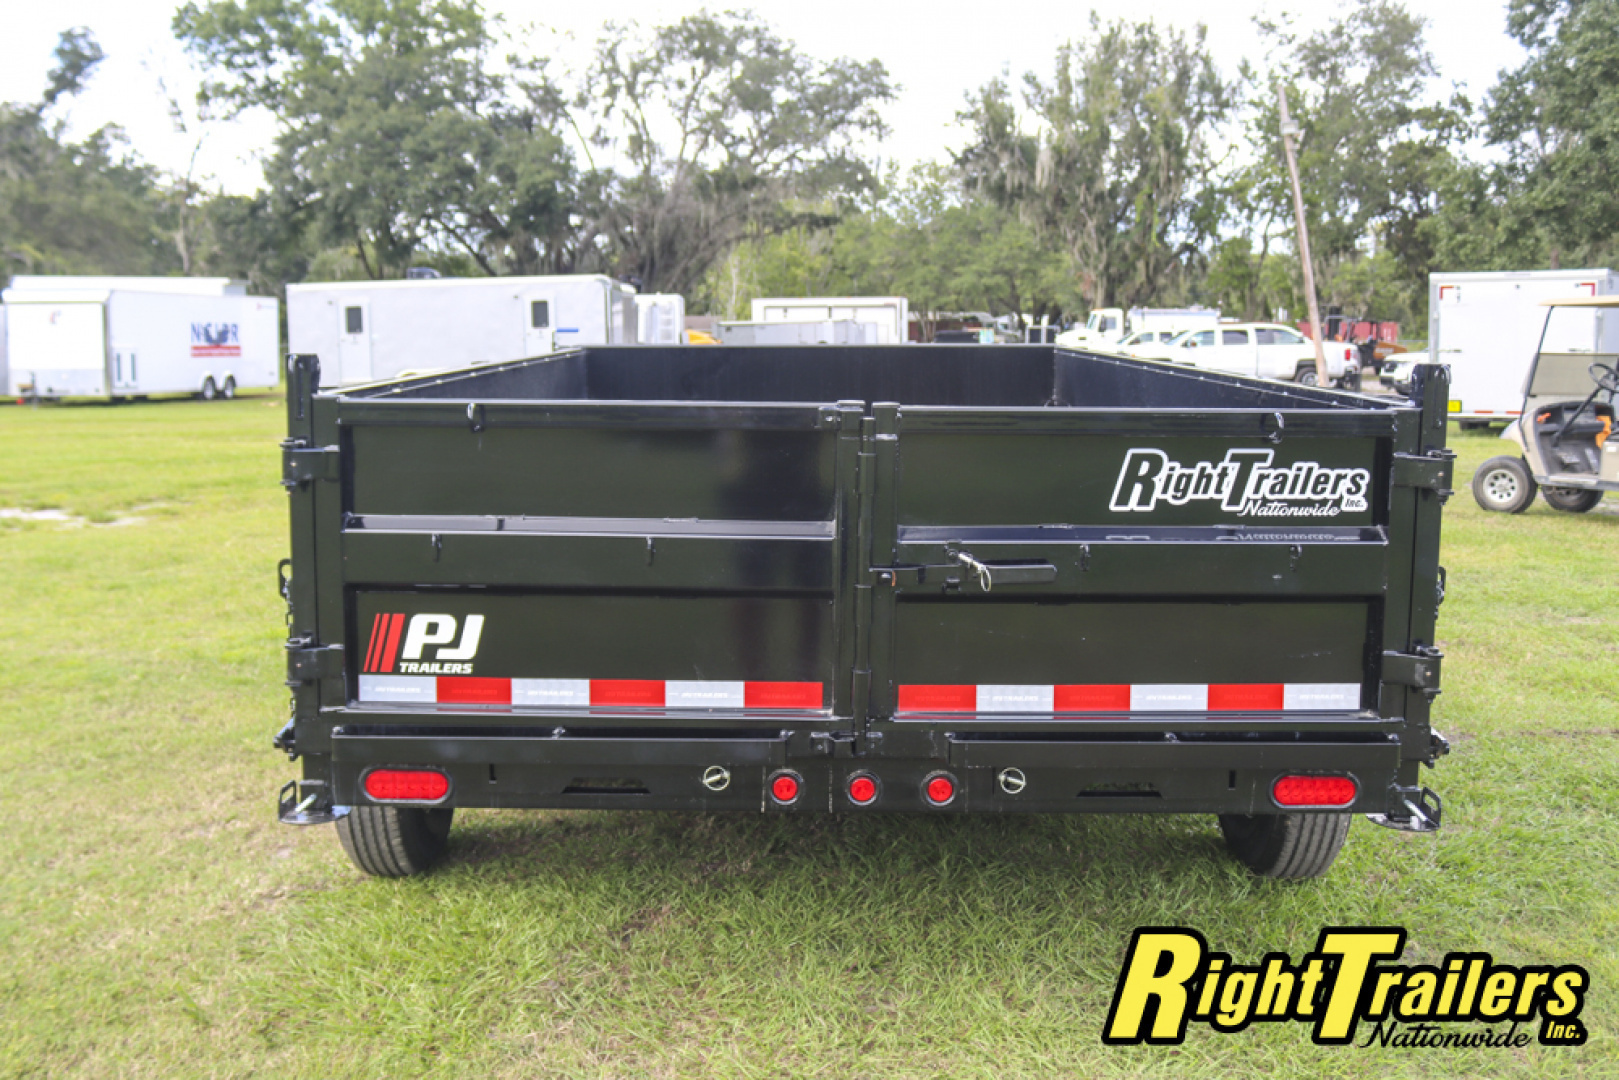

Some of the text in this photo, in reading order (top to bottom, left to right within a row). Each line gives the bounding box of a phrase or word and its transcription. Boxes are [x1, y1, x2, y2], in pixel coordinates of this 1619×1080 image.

[1237, 499, 1341, 517] Nationwide
[1343, 498, 1366, 509] Inc.
[402, 613, 485, 660] PJ
[399, 661, 474, 675] TRAILERS
